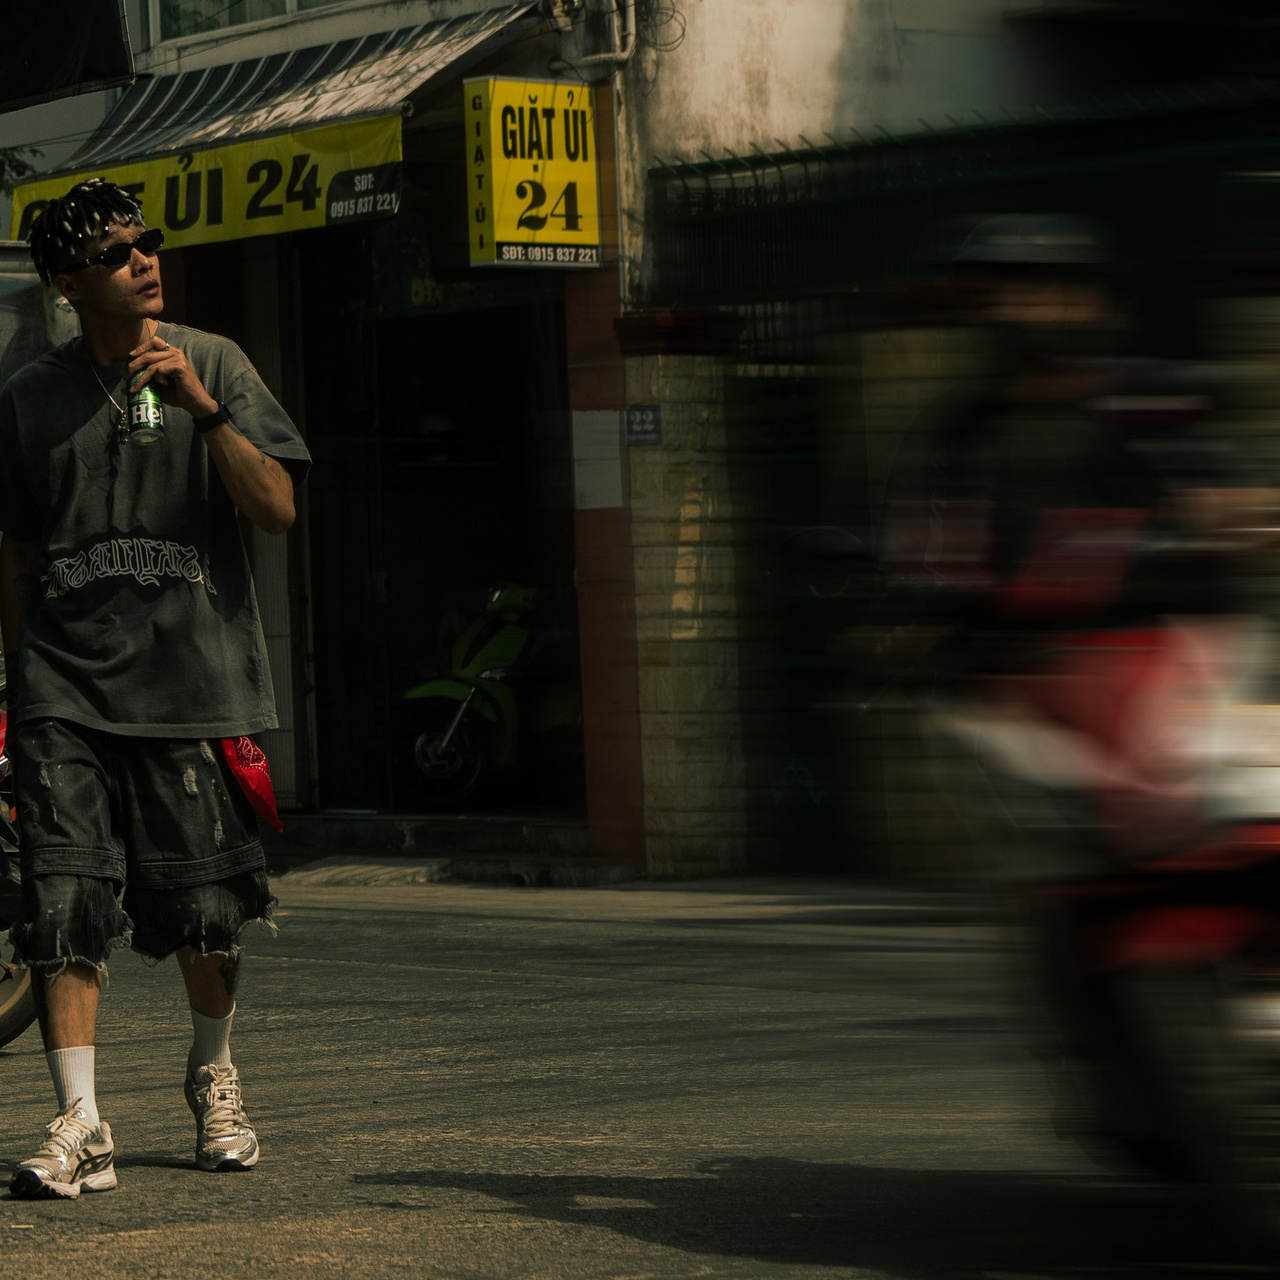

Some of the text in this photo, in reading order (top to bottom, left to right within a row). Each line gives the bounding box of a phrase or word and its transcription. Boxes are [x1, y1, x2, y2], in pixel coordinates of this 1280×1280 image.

[501, 91, 588, 172] GIẶT ỦI
[245, 154, 322, 220] 24
[331, 192, 396, 218] 0915 837 221
[516, 180, 583, 232] 24
[527, 246, 554, 262] 0915
[556, 247, 575, 262] 837
[578, 248, 597, 263] 221
[631, 411, 654, 431] 22
